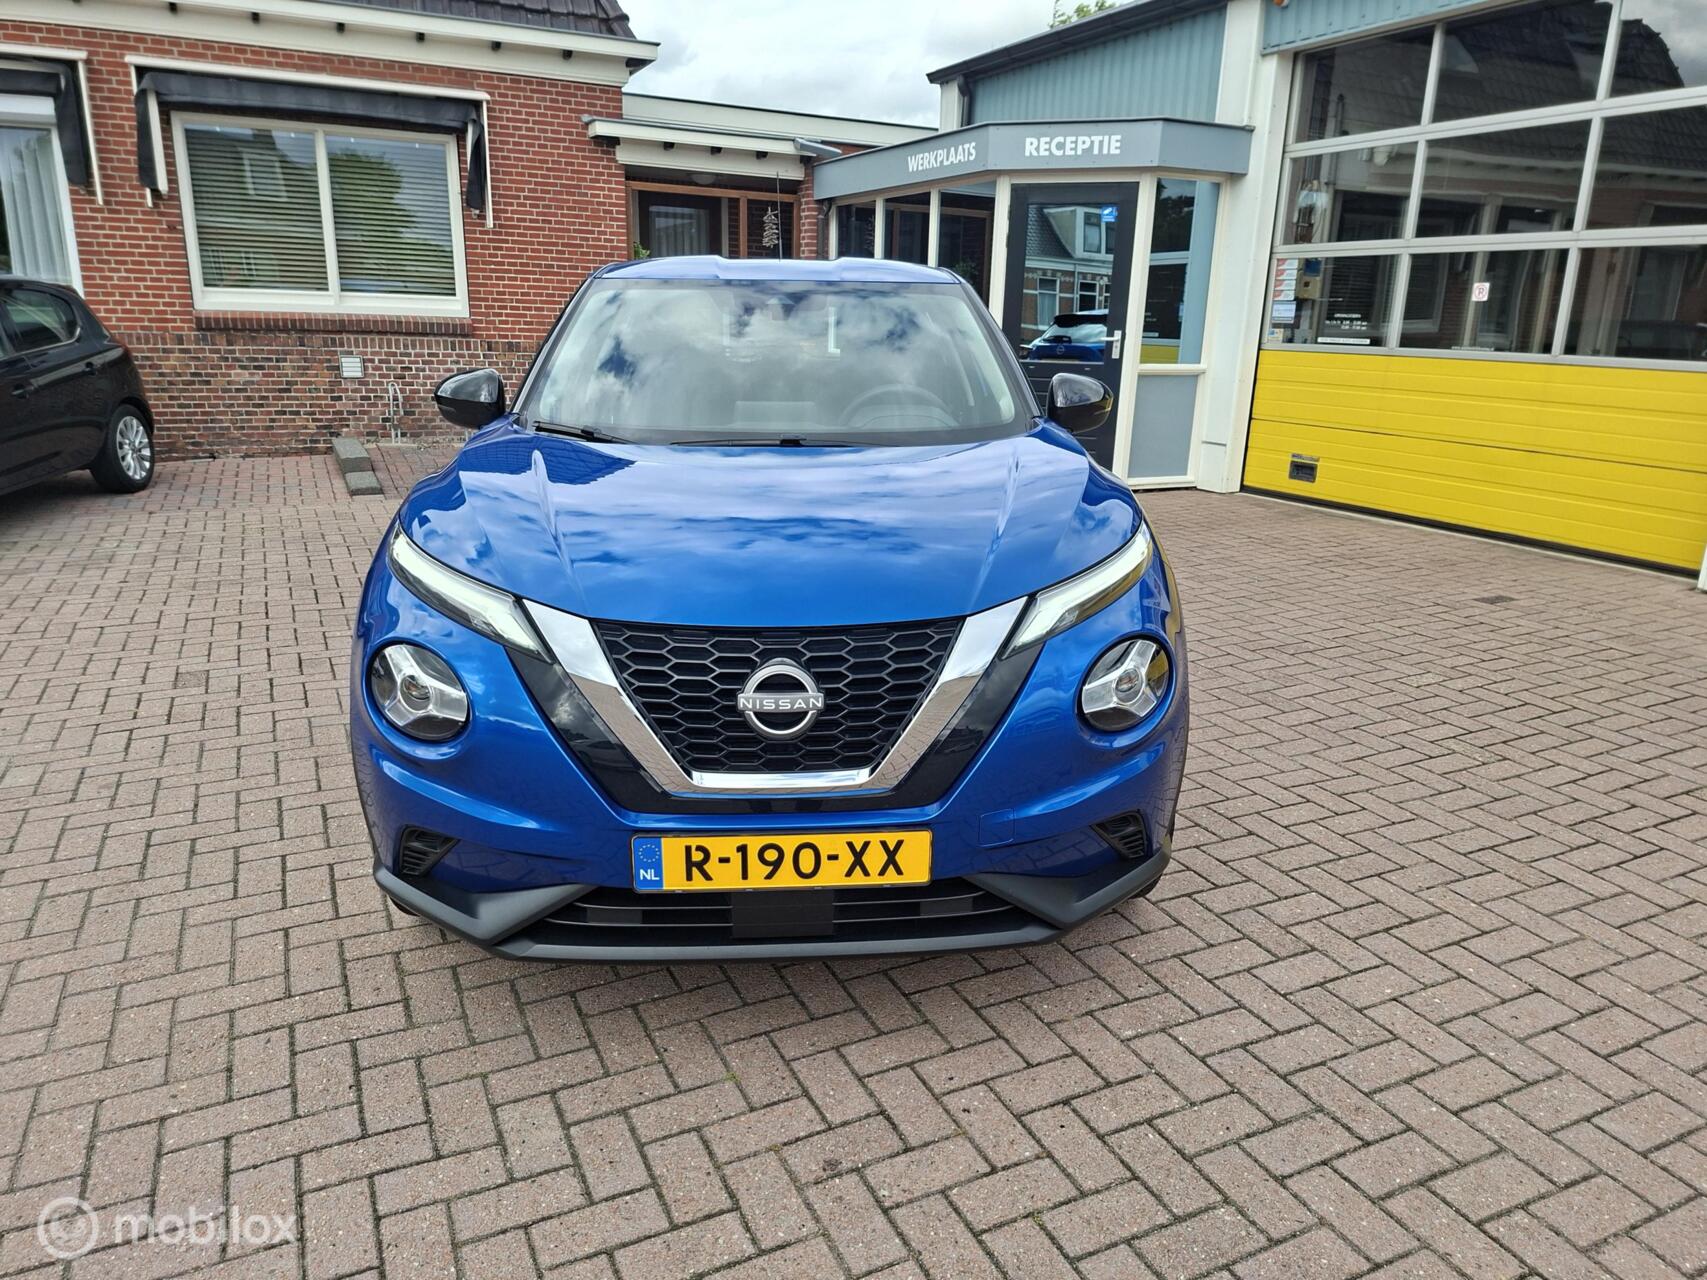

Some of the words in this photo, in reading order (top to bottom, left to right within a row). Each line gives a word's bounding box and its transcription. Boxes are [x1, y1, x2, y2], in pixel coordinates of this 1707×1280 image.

[1025, 135, 1122, 156] RECEPTIE
[907, 142, 977, 172] WERKPLAATS
[740, 697, 822, 710] NISSAN
[685, 839, 905, 881] R-190-XX
[639, 869, 660, 881] NL
